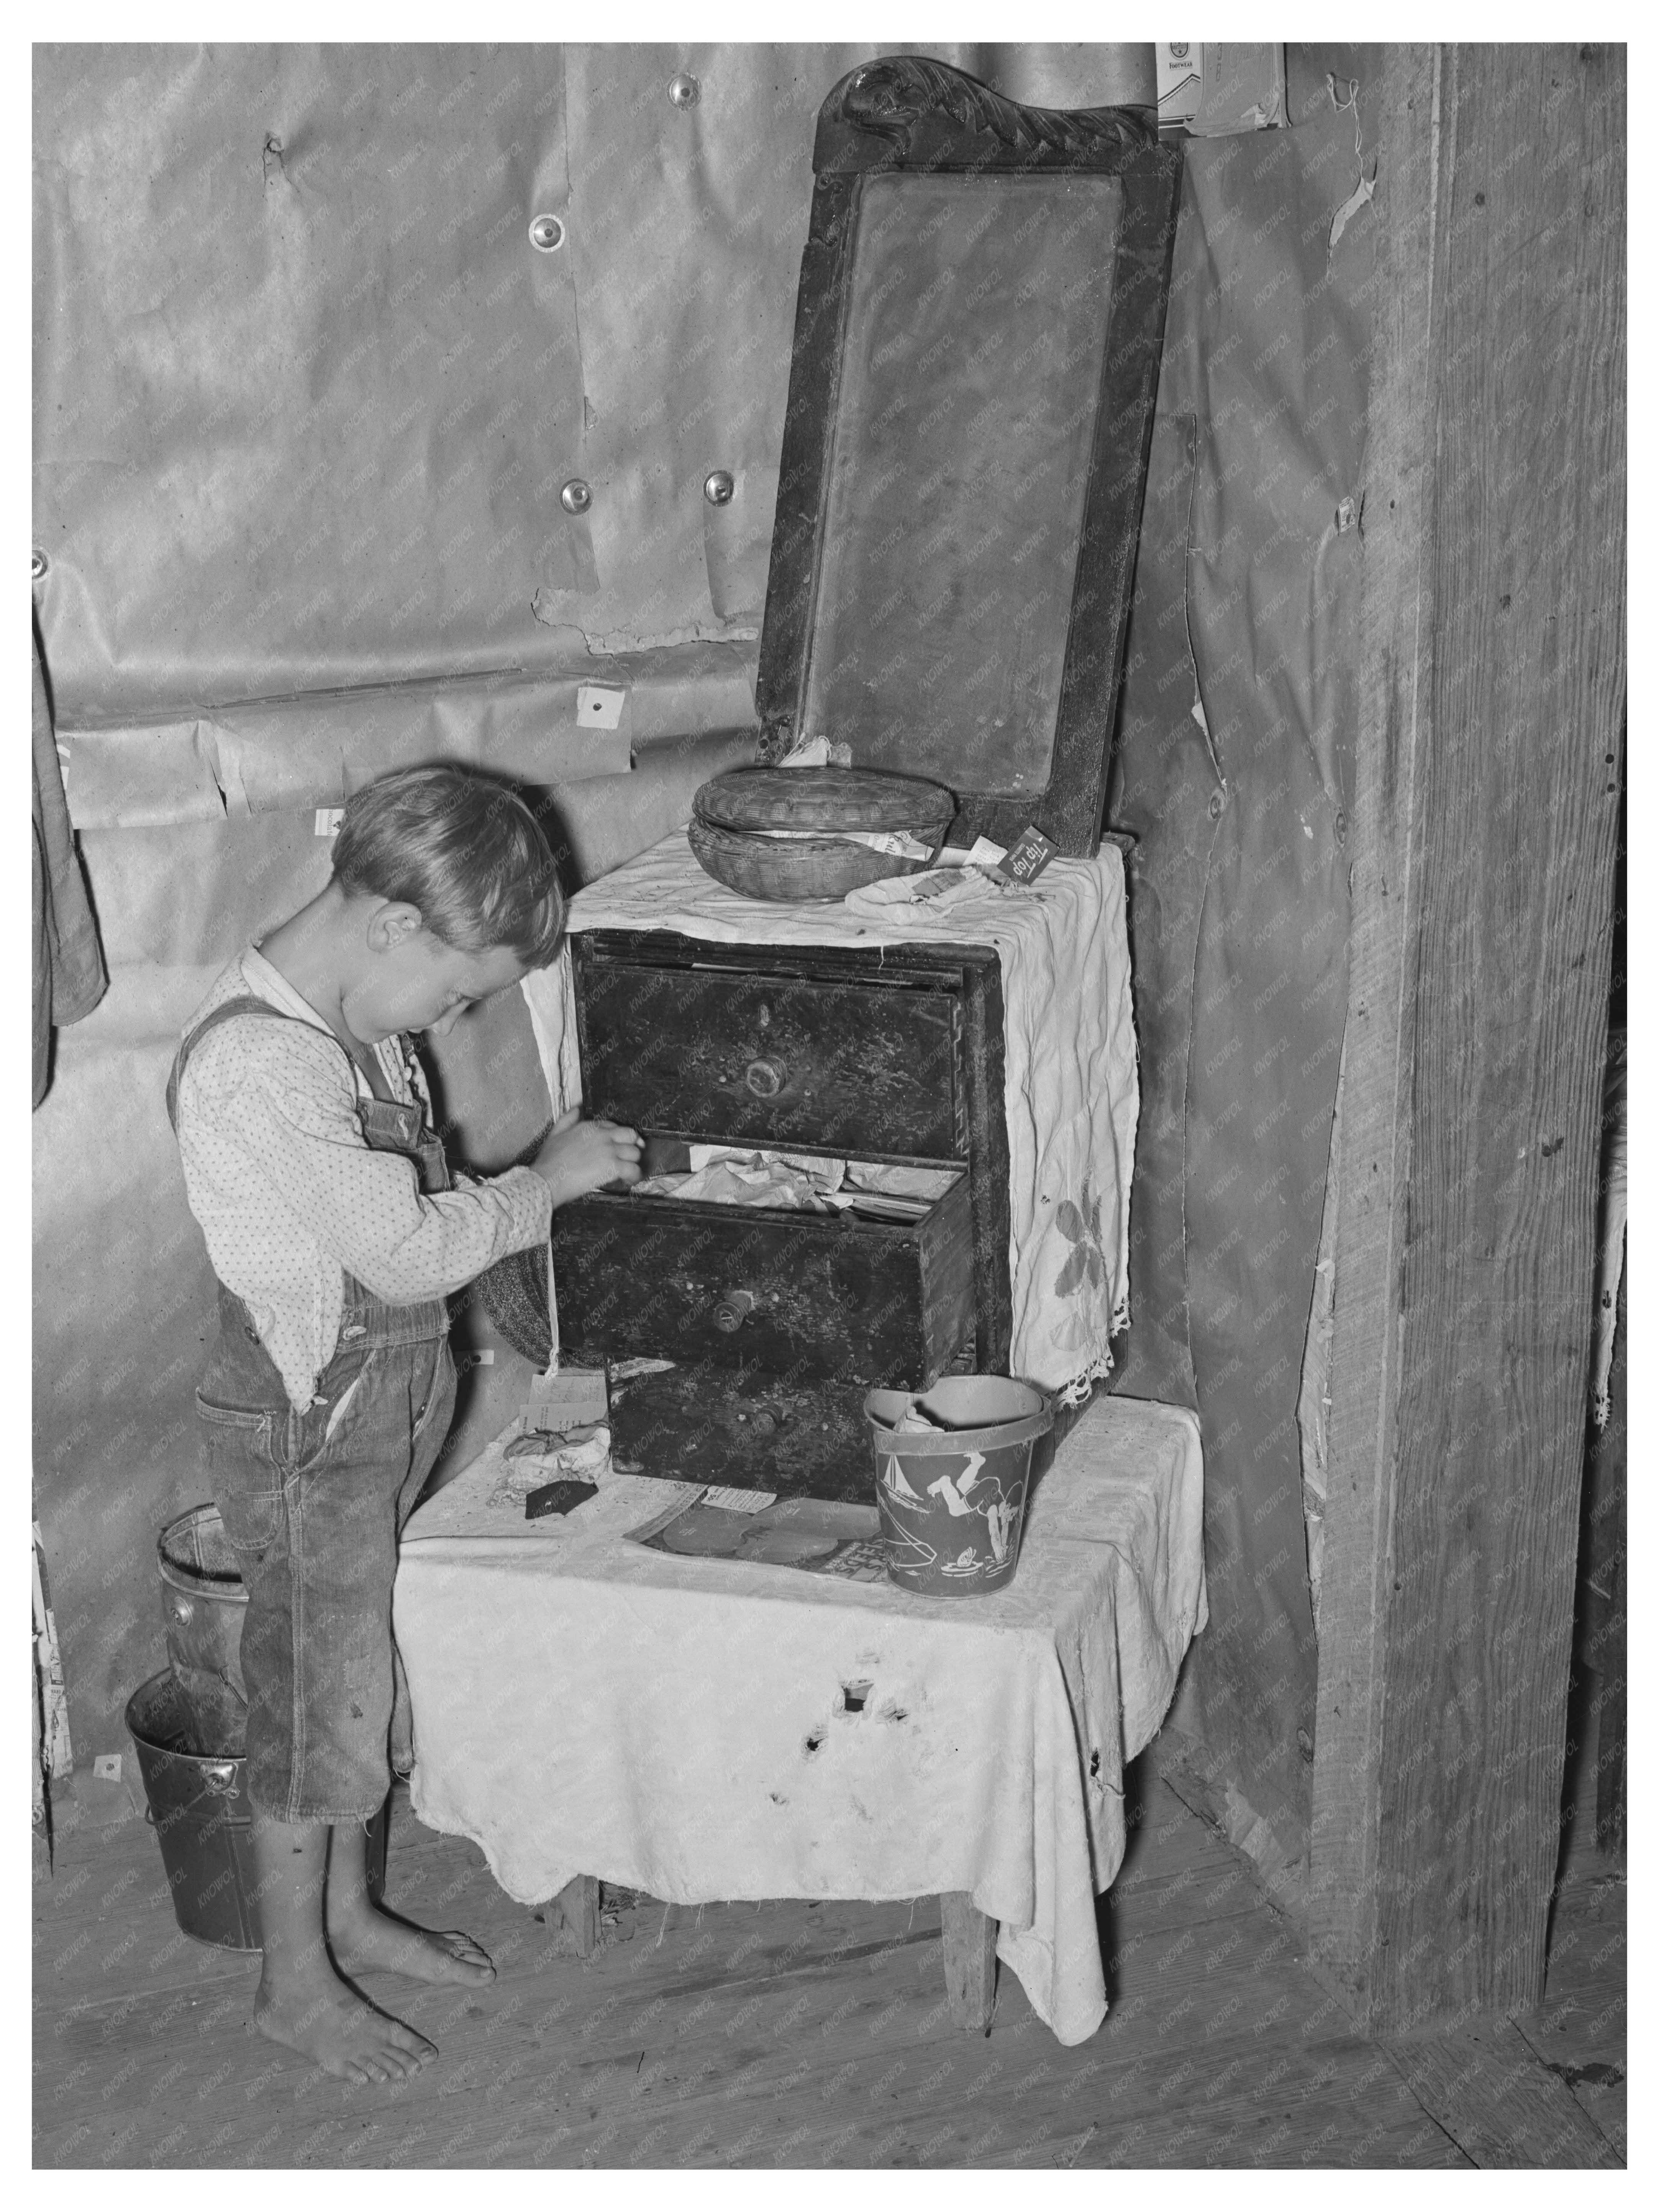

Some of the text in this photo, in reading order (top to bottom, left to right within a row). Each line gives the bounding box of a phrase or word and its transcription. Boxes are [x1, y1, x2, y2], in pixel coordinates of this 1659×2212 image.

[1013, 843, 1048, 878] Tip Top
[680, 1492, 697, 1507] SEED
